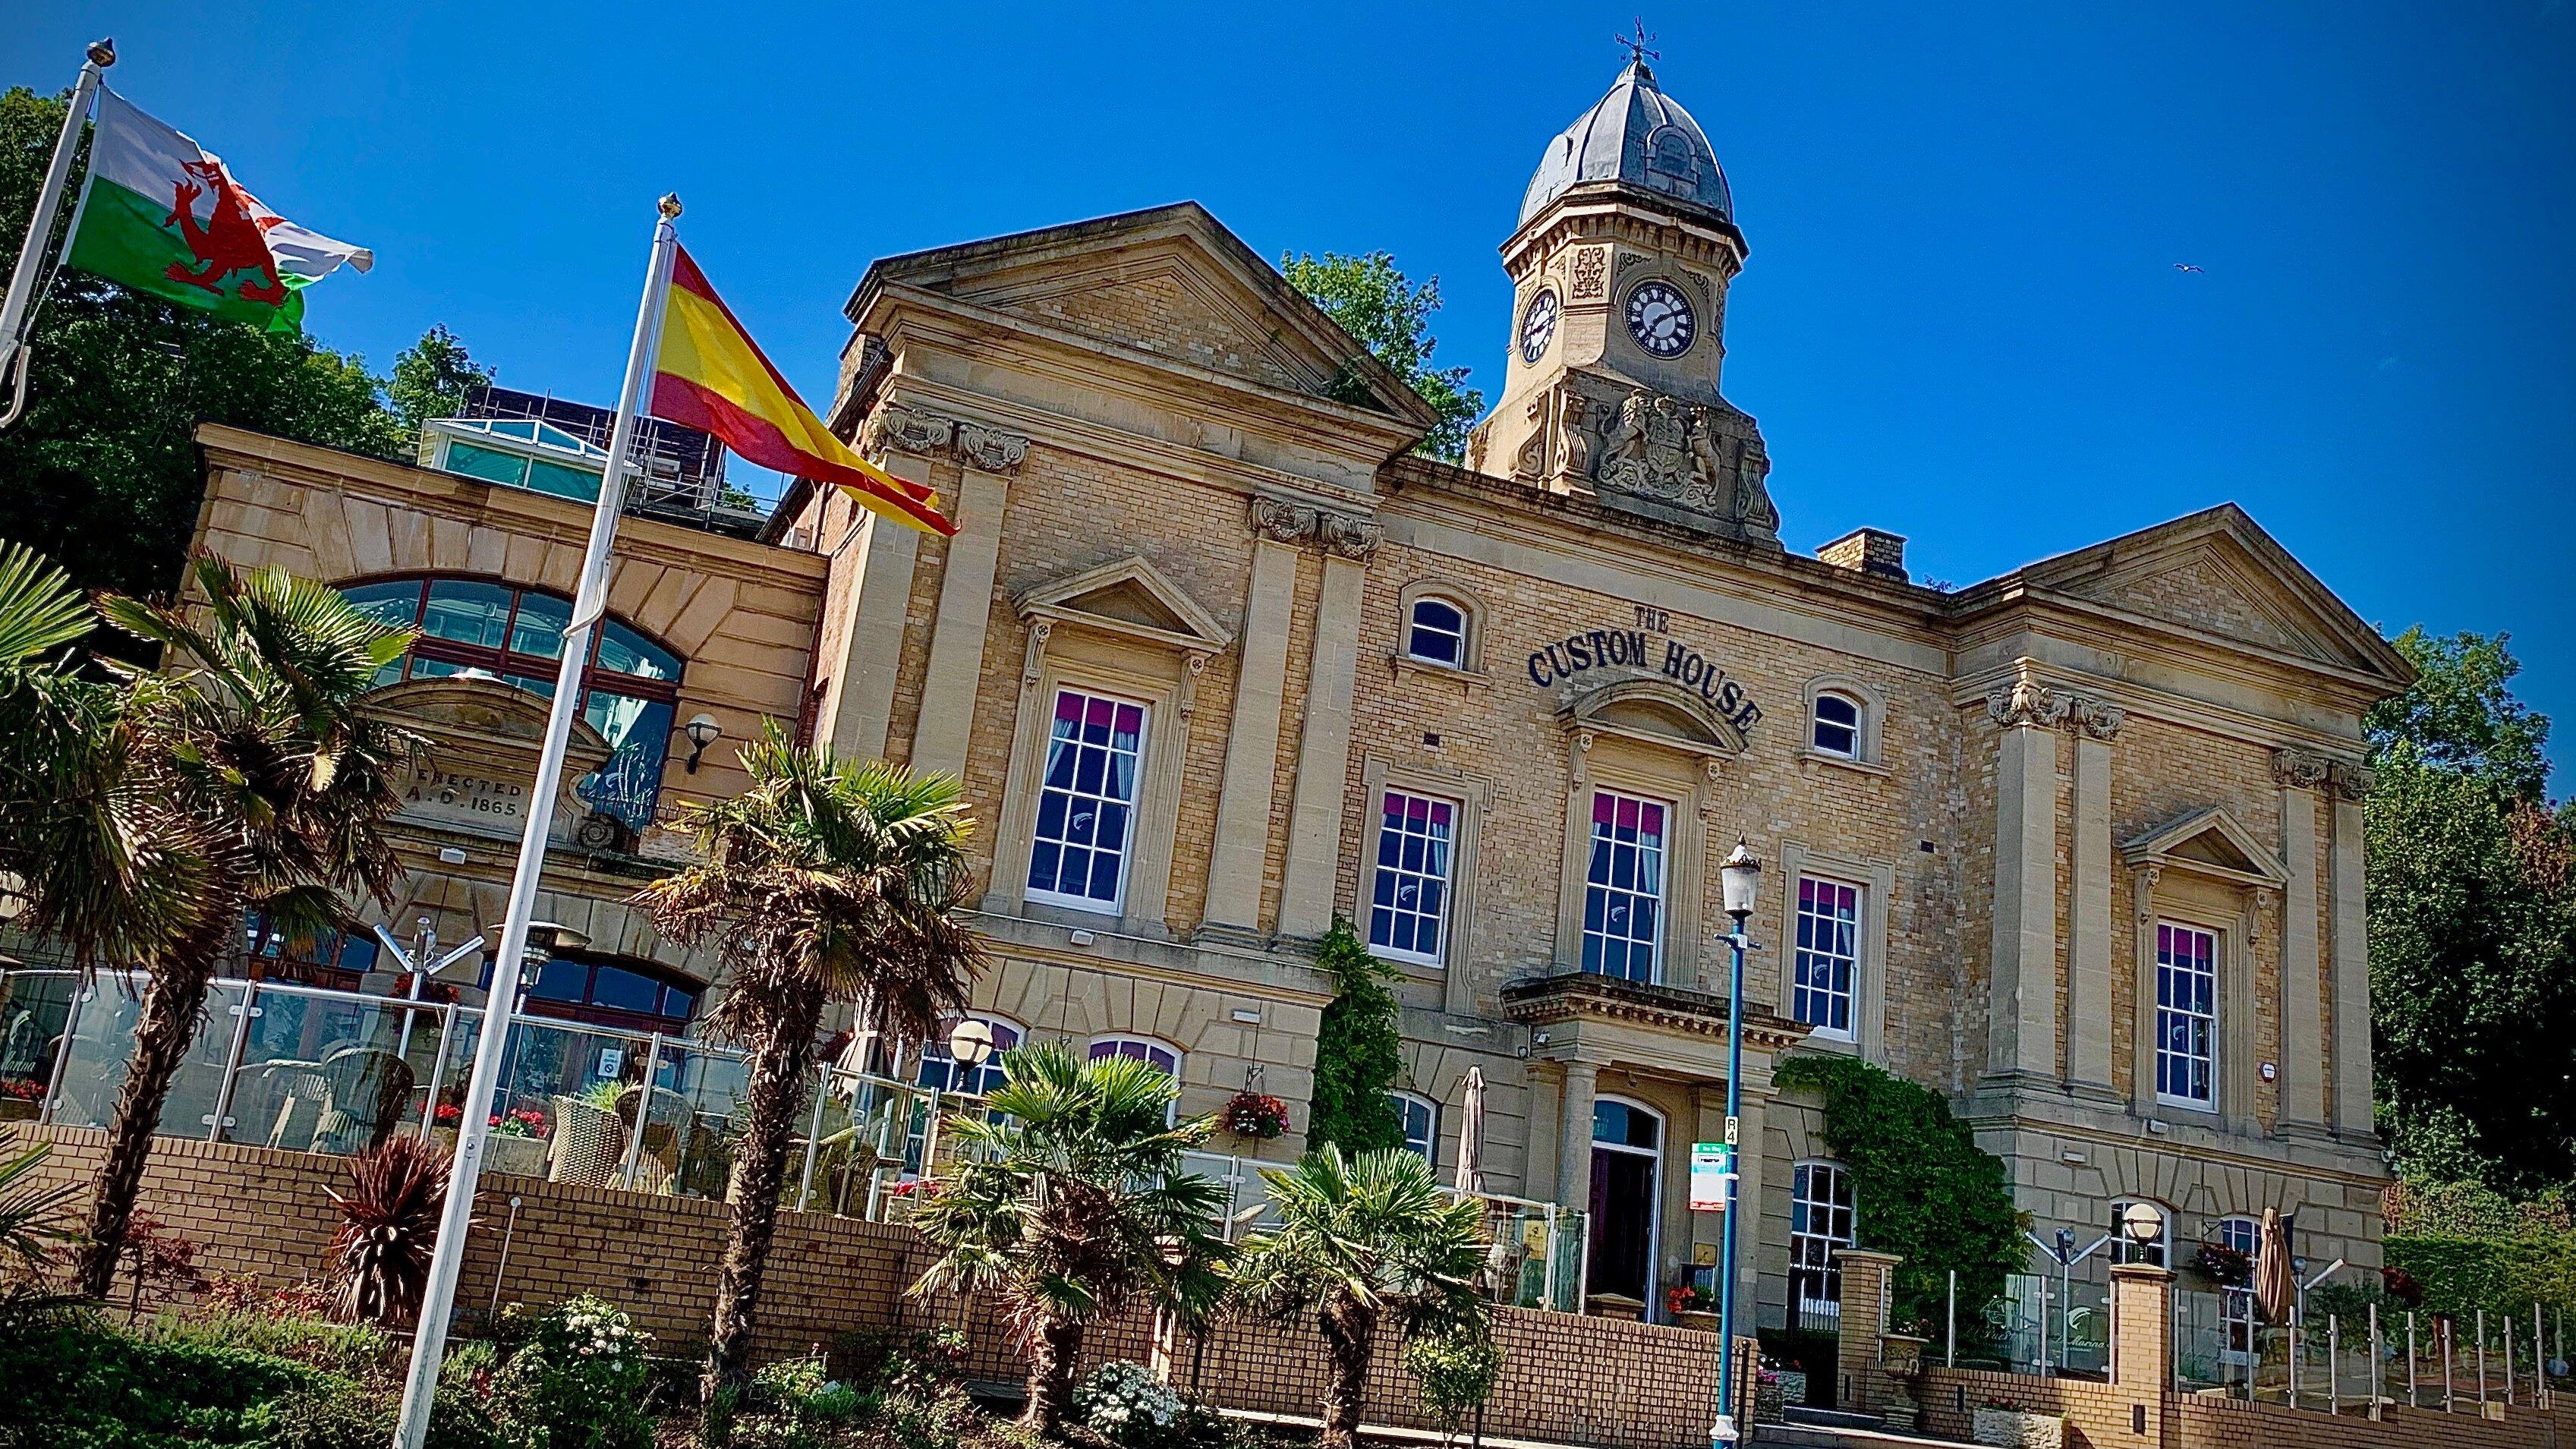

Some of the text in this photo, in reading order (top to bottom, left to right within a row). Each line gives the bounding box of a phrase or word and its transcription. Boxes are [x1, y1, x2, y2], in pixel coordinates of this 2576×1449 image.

[1634, 606, 1670, 634] THE
[1529, 630, 1764, 736] CUSTOM HOUSE
[417, 768, 521, 797] ERECTED
[1727, 1118, 1737, 1130] R
[1727, 1130, 1735, 1142] 4
